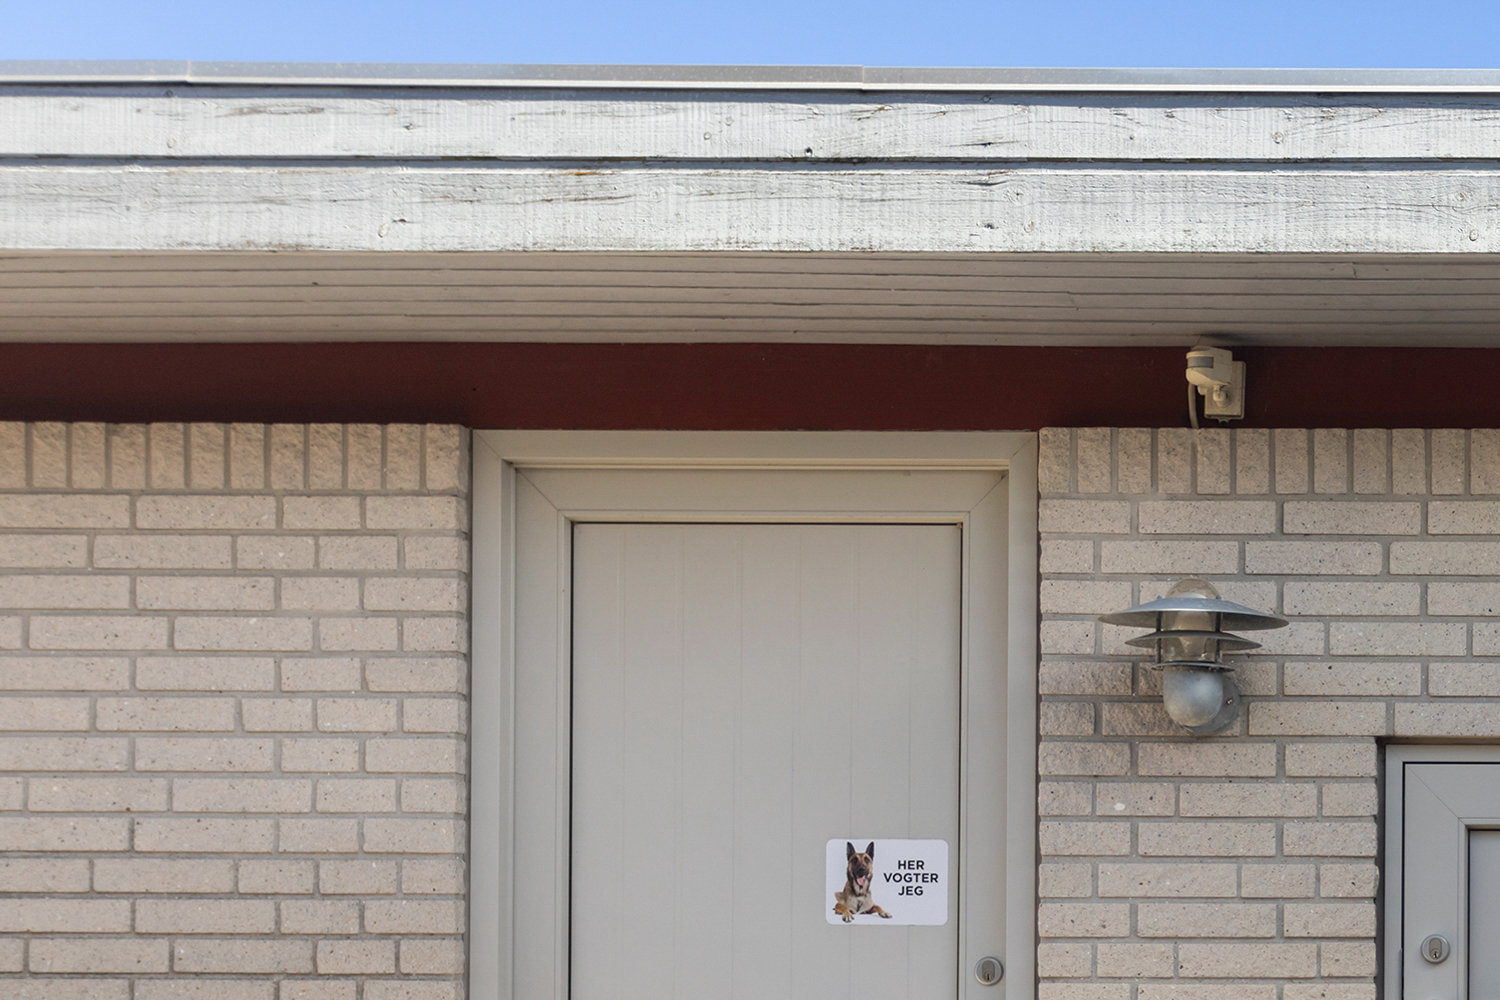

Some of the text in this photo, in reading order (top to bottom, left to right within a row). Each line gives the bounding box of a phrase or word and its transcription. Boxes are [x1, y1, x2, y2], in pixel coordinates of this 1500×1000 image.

[897, 860, 925, 870] HER
[883, 873, 939, 883] VOGTER
[898, 886, 924, 896] JEG
